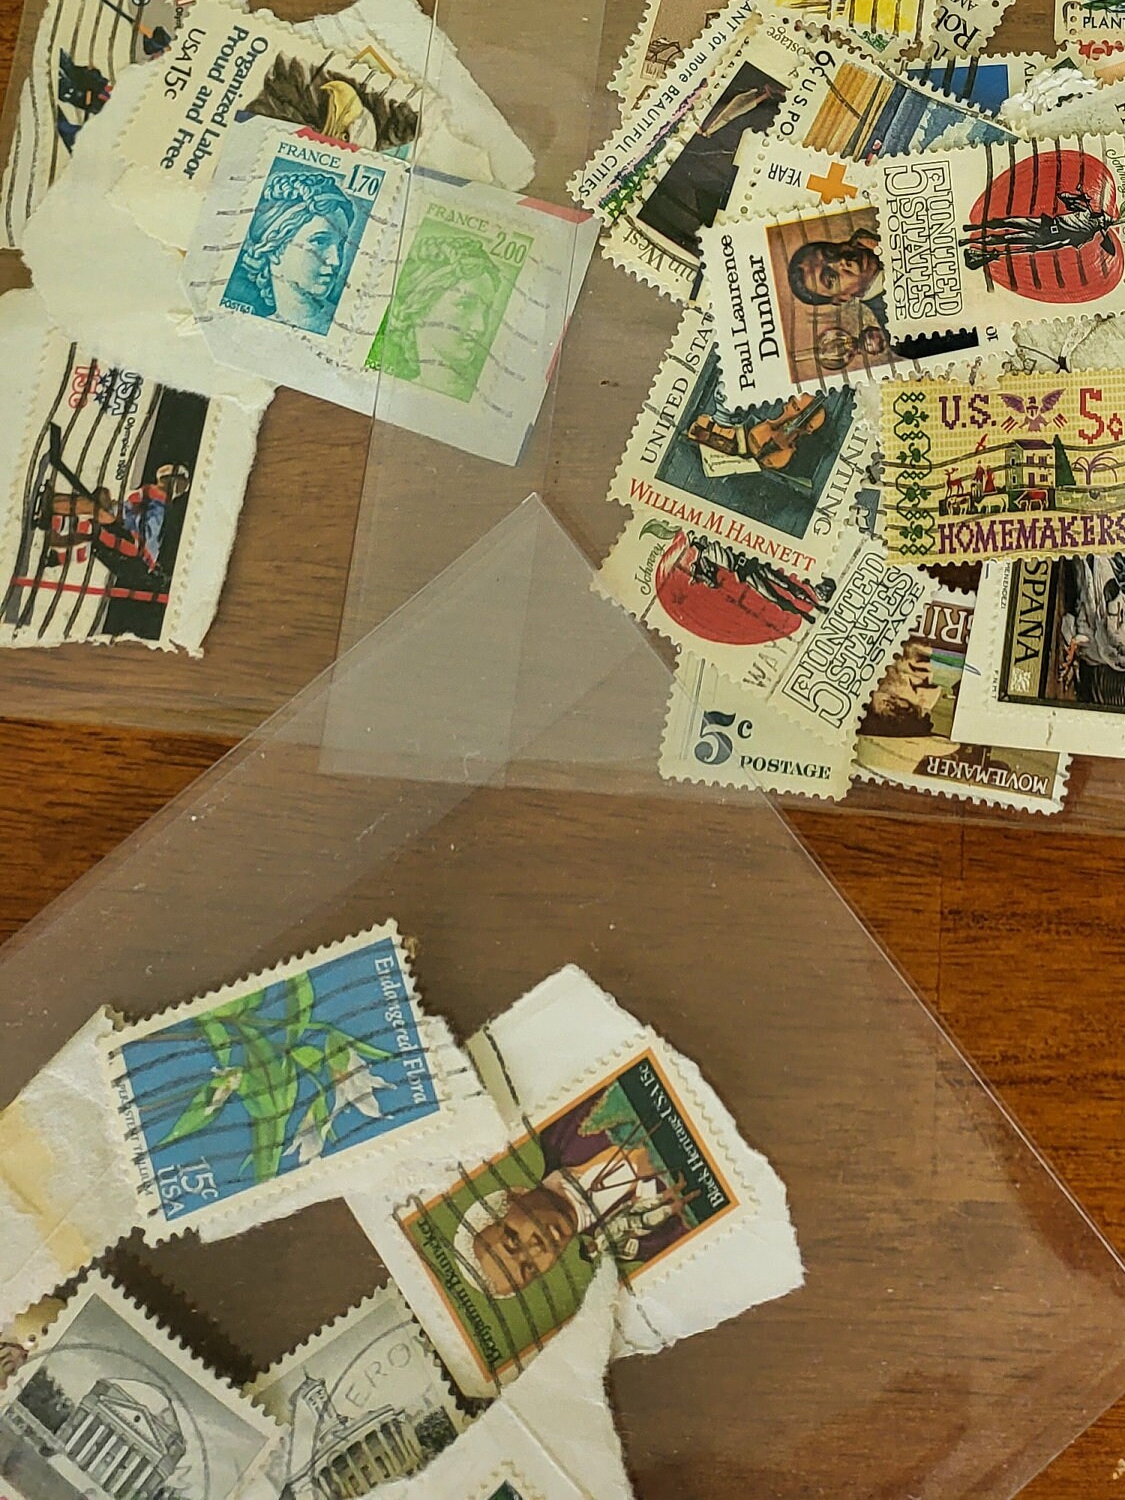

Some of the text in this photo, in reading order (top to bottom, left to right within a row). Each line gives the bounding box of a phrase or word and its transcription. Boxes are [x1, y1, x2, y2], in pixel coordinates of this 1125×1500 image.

[174, 27, 207, 63] USA
[678, 53, 709, 84] more
[707, 31, 728, 52] for
[766, 25, 809, 61] ostage
[159, 24, 250, 171] Proud and Free
[182, 35, 270, 181] Organized Labor
[614, 84, 681, 154] BEAUTIFUL
[276, 141, 342, 171] FRANCE
[577, 154, 619, 198] CITIES
[767, 161, 803, 188] YEAR
[425, 201, 491, 234] FRANCE
[622, 225, 667, 273] West
[885, 198, 908, 321] POSTAGE
[899, 196, 938, 321] STATES
[927, 190, 964, 317] UNITED
[720, 233, 756, 392] Paul Laurence
[749, 254, 780, 362] Dunbar
[639, 375, 690, 466] UNITED
[938, 392, 997, 431] U.S.
[813, 432, 869, 537] INTING
[628, 477, 702, 527] WILLIAM
[724, 518, 817, 573] HARNETT
[634, 542, 667, 596] Johnny
[799, 551, 889, 673] UNITED
[824, 564, 914, 691] STATES
[849, 581, 926, 700] POSTAGE
[739, 754, 832, 781] POSTAGE
[926, 755, 1050, 795] MOVIEMAKER
[373, 954, 429, 1105] Endangered Flora
[666, 1114, 706, 1173] Heritage
[156, 1163, 185, 1218] USA
[697, 1165, 727, 1208] Black
[417, 1217, 502, 1364] Benjamin Banneker
